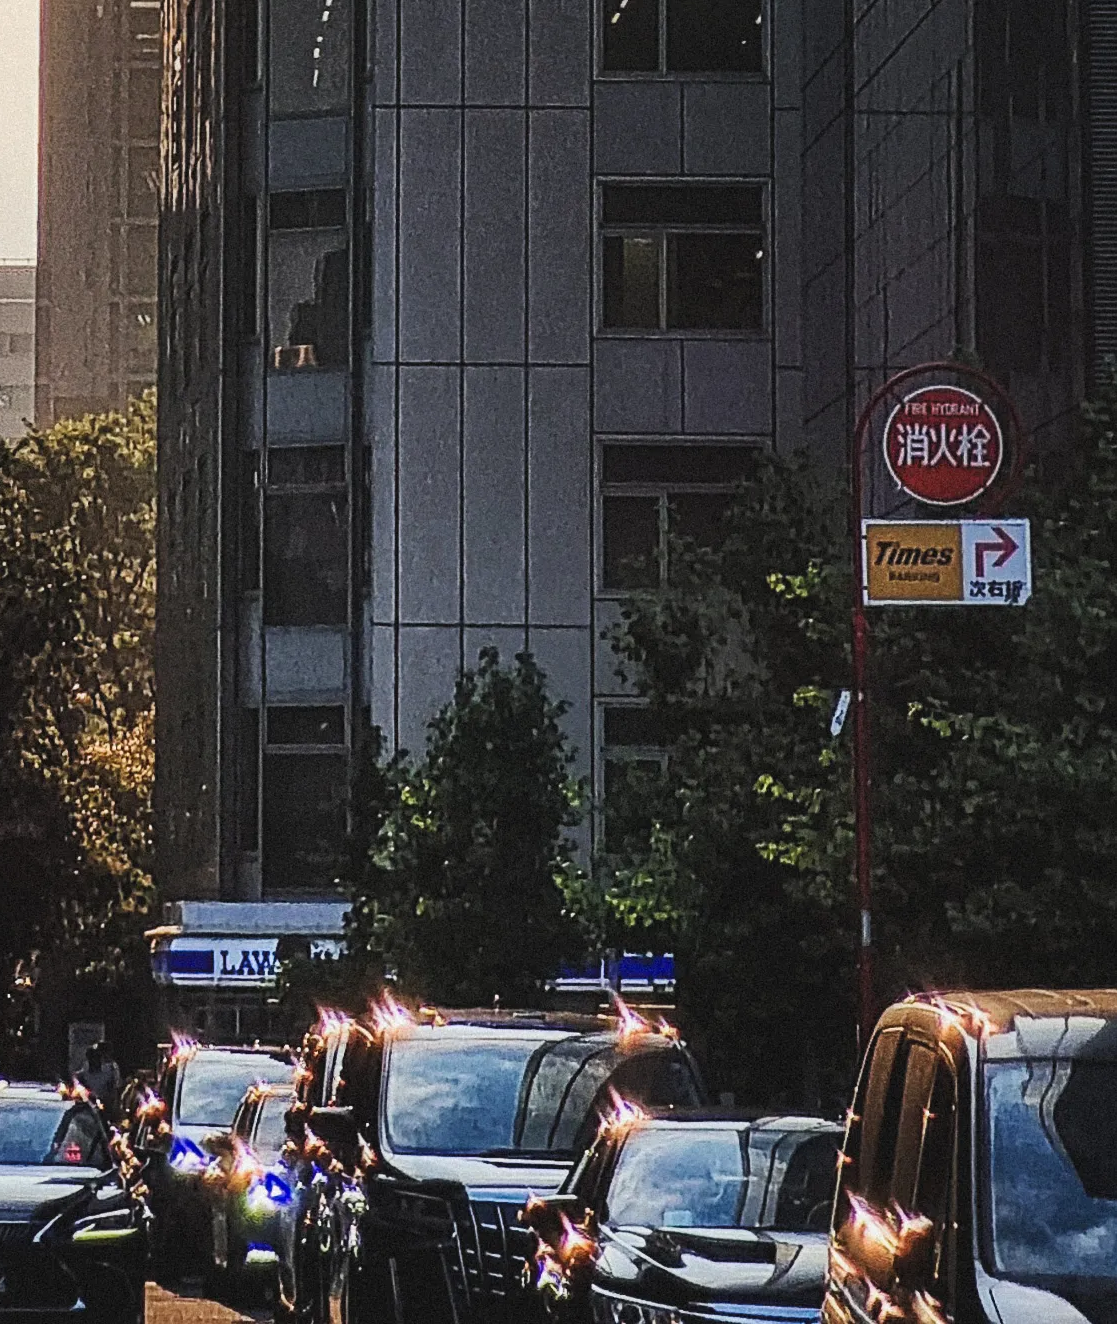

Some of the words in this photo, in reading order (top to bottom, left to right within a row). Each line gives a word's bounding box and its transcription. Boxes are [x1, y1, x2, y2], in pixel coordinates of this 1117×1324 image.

[904, 402, 928, 416] FIRE
[931, 402, 980, 417] HYDRANT
[895, 422, 992, 467] 消火栓
[873, 540, 955, 566] Times
